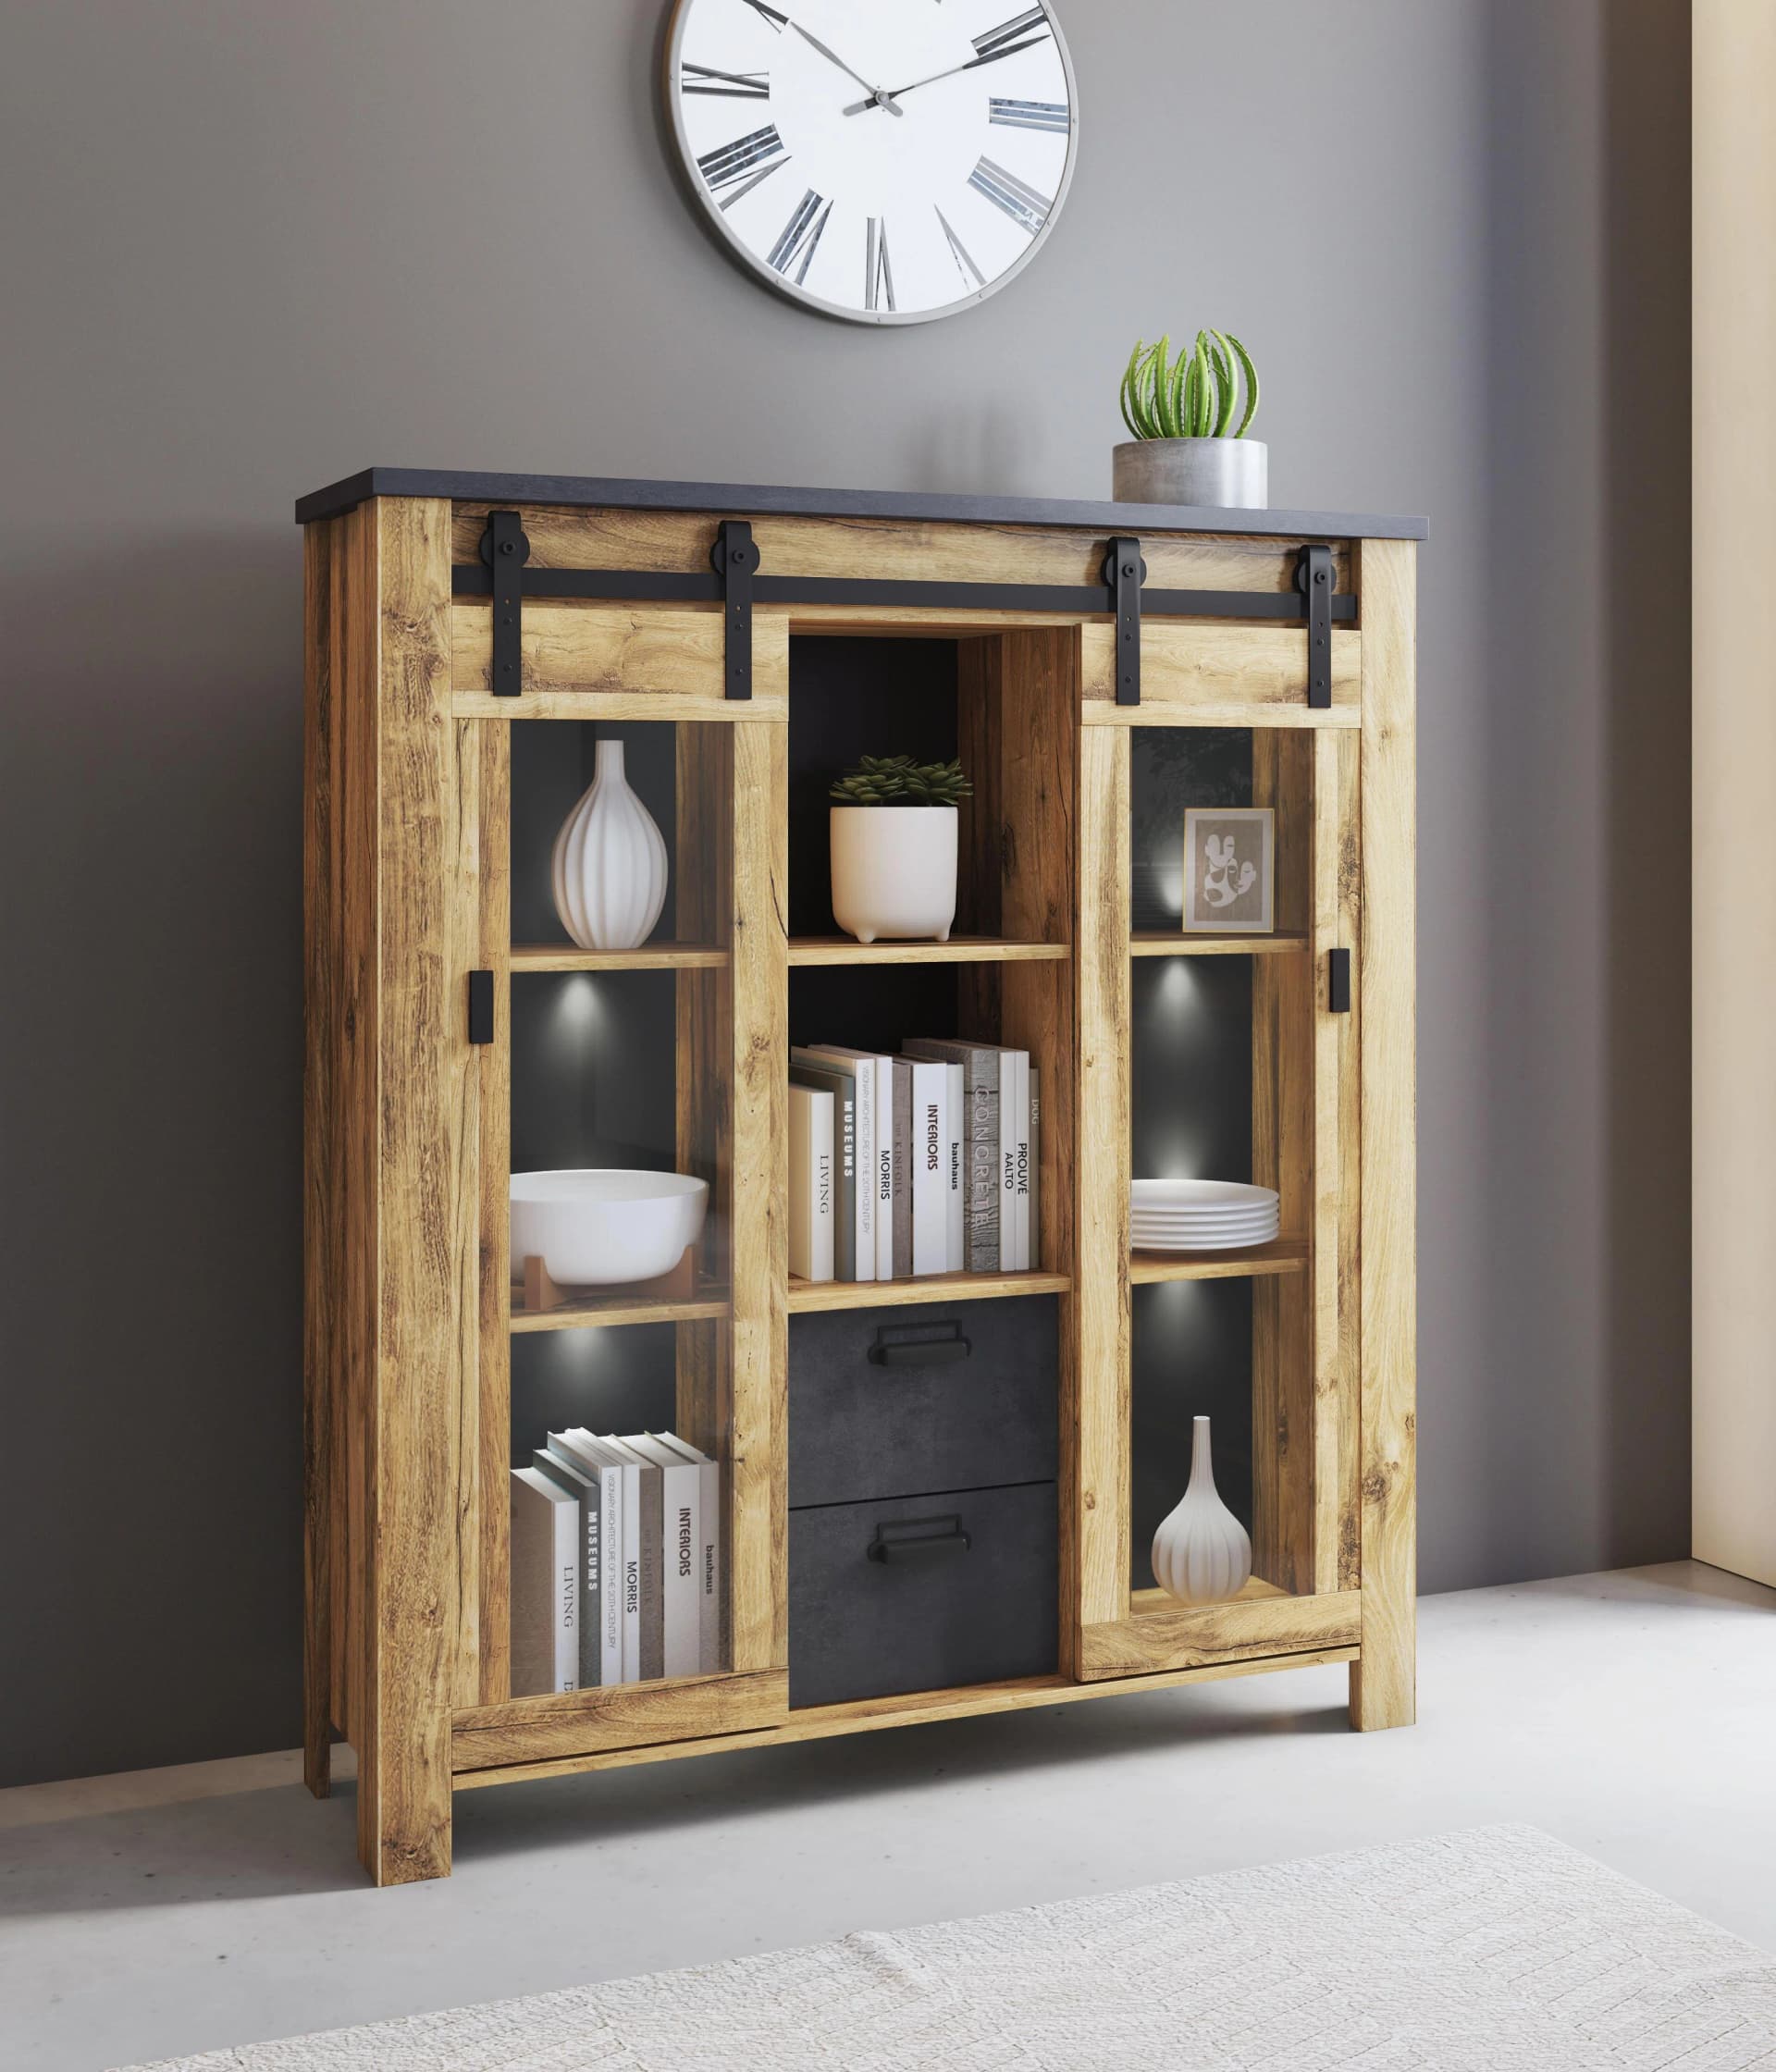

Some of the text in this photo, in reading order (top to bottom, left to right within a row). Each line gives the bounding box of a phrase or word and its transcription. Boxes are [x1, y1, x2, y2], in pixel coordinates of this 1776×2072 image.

[682, 60, 770, 102] IX
[989, 97, 1070, 134] III
[844, 1100, 854, 1178] MUSEUMS
[927, 1104, 938, 1171] INTERIORS
[1031, 1099, 1040, 1125] DOG
[881, 1150, 891, 1201] MORRIS
[951, 1142, 959, 1190] bauhaus
[974, 1086, 990, 1226] CONCRETE
[1005, 1152, 1014, 1190] AALTO
[820, 1155, 830, 1215] LIVING
[587, 1511, 598, 1591] MUSEUMS
[679, 1507, 691, 1577] INTERIORS
[564, 1565, 574, 1628] LIVING
[627, 1560, 637, 1614] MORRIS
[706, 1544, 715, 1596] bauhaus
